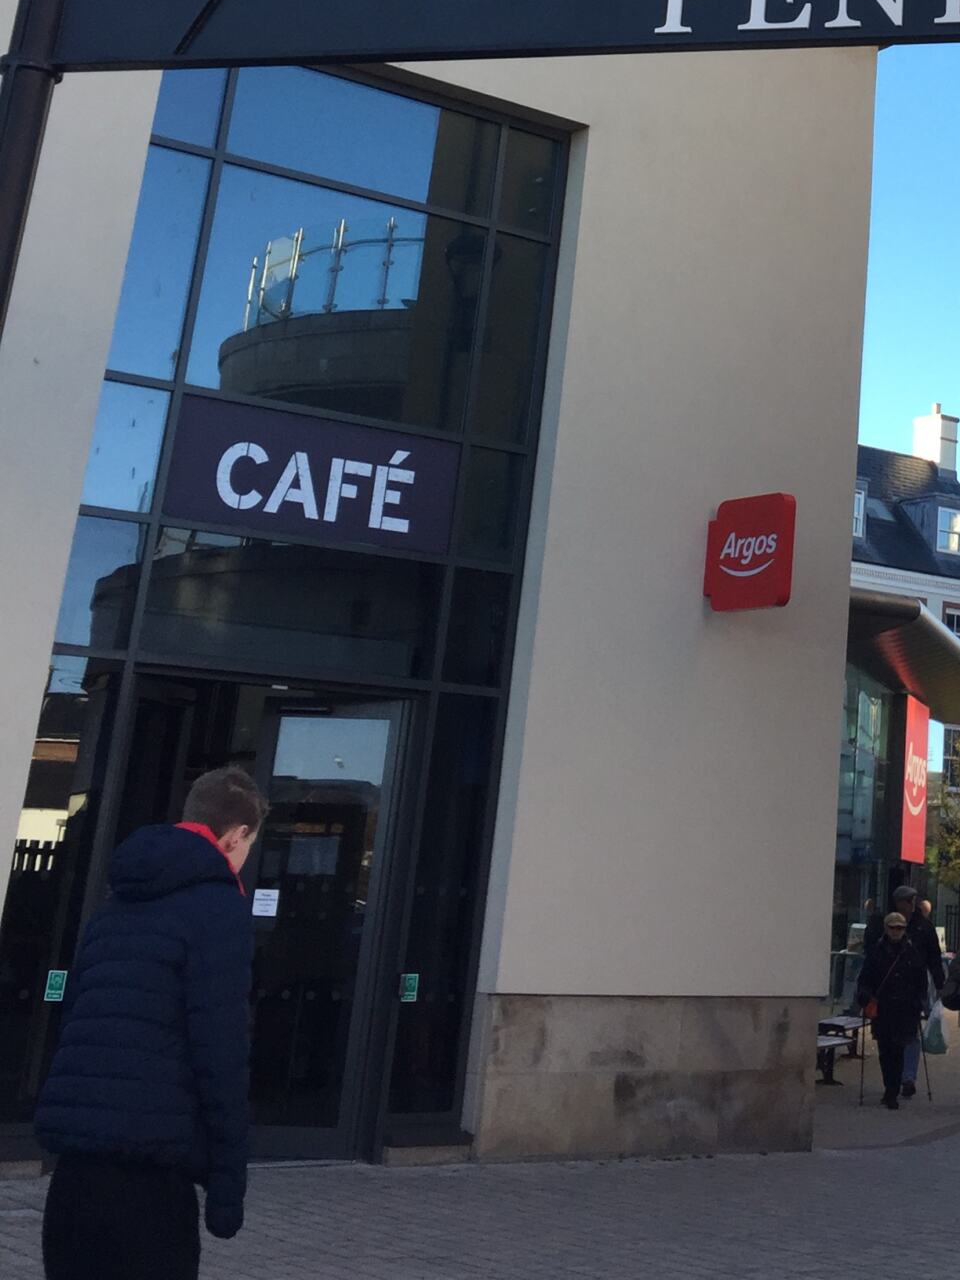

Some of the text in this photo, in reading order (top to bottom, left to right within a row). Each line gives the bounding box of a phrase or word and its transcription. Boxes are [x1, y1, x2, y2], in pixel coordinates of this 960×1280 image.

[216, 441, 416, 534] CAFÉ
[719, 531, 778, 565] Argos
[905, 741, 927, 797] Argos
